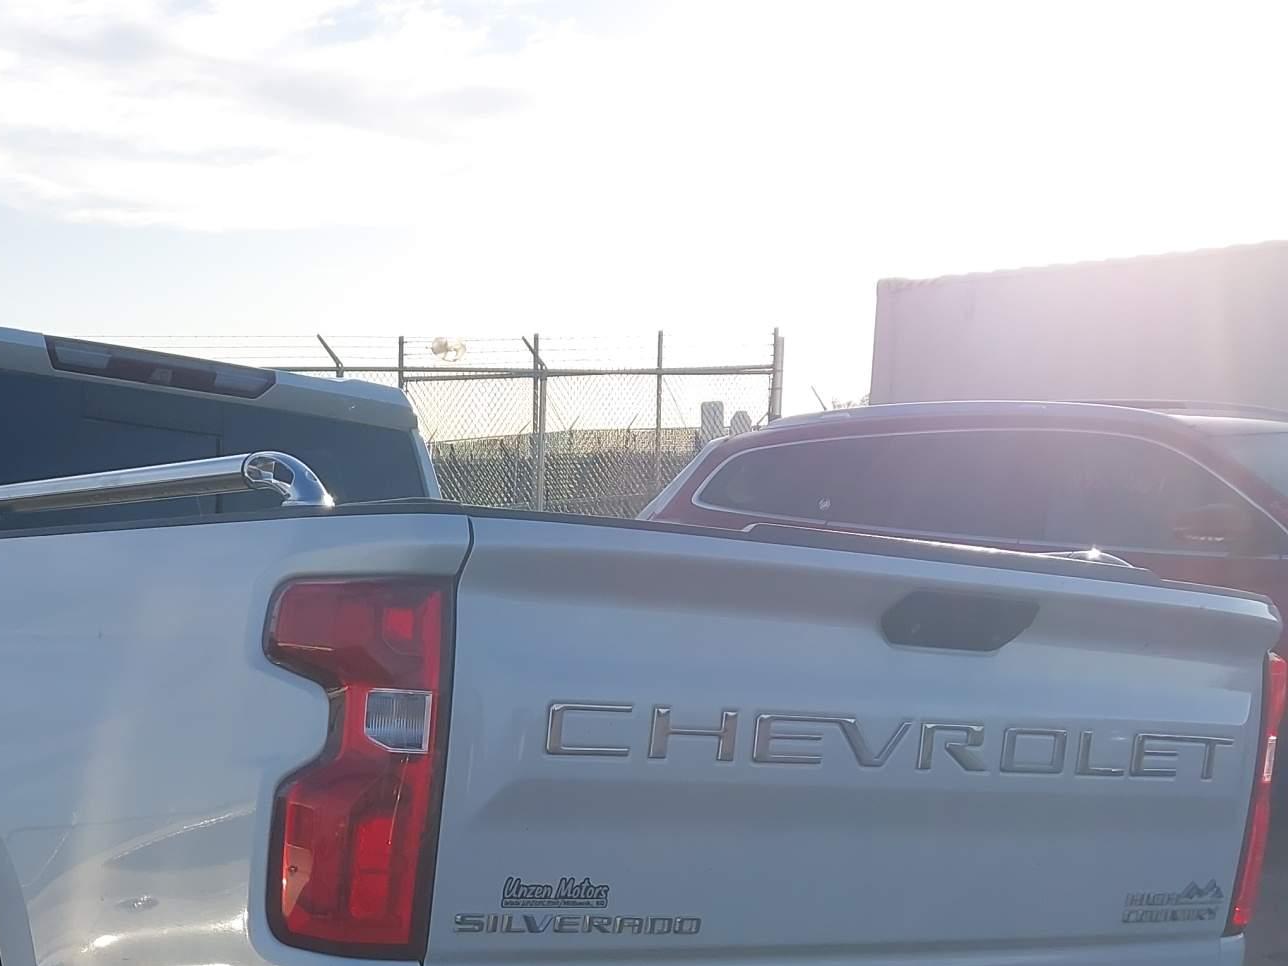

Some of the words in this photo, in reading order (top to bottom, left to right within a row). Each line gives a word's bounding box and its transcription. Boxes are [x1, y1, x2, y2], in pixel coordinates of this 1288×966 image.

[546, 702, 1235, 781] CHEVROLET
[502, 877, 553, 899] Unzen
[555, 877, 610, 899] Motors
[453, 913, 702, 936] SILVERADO
